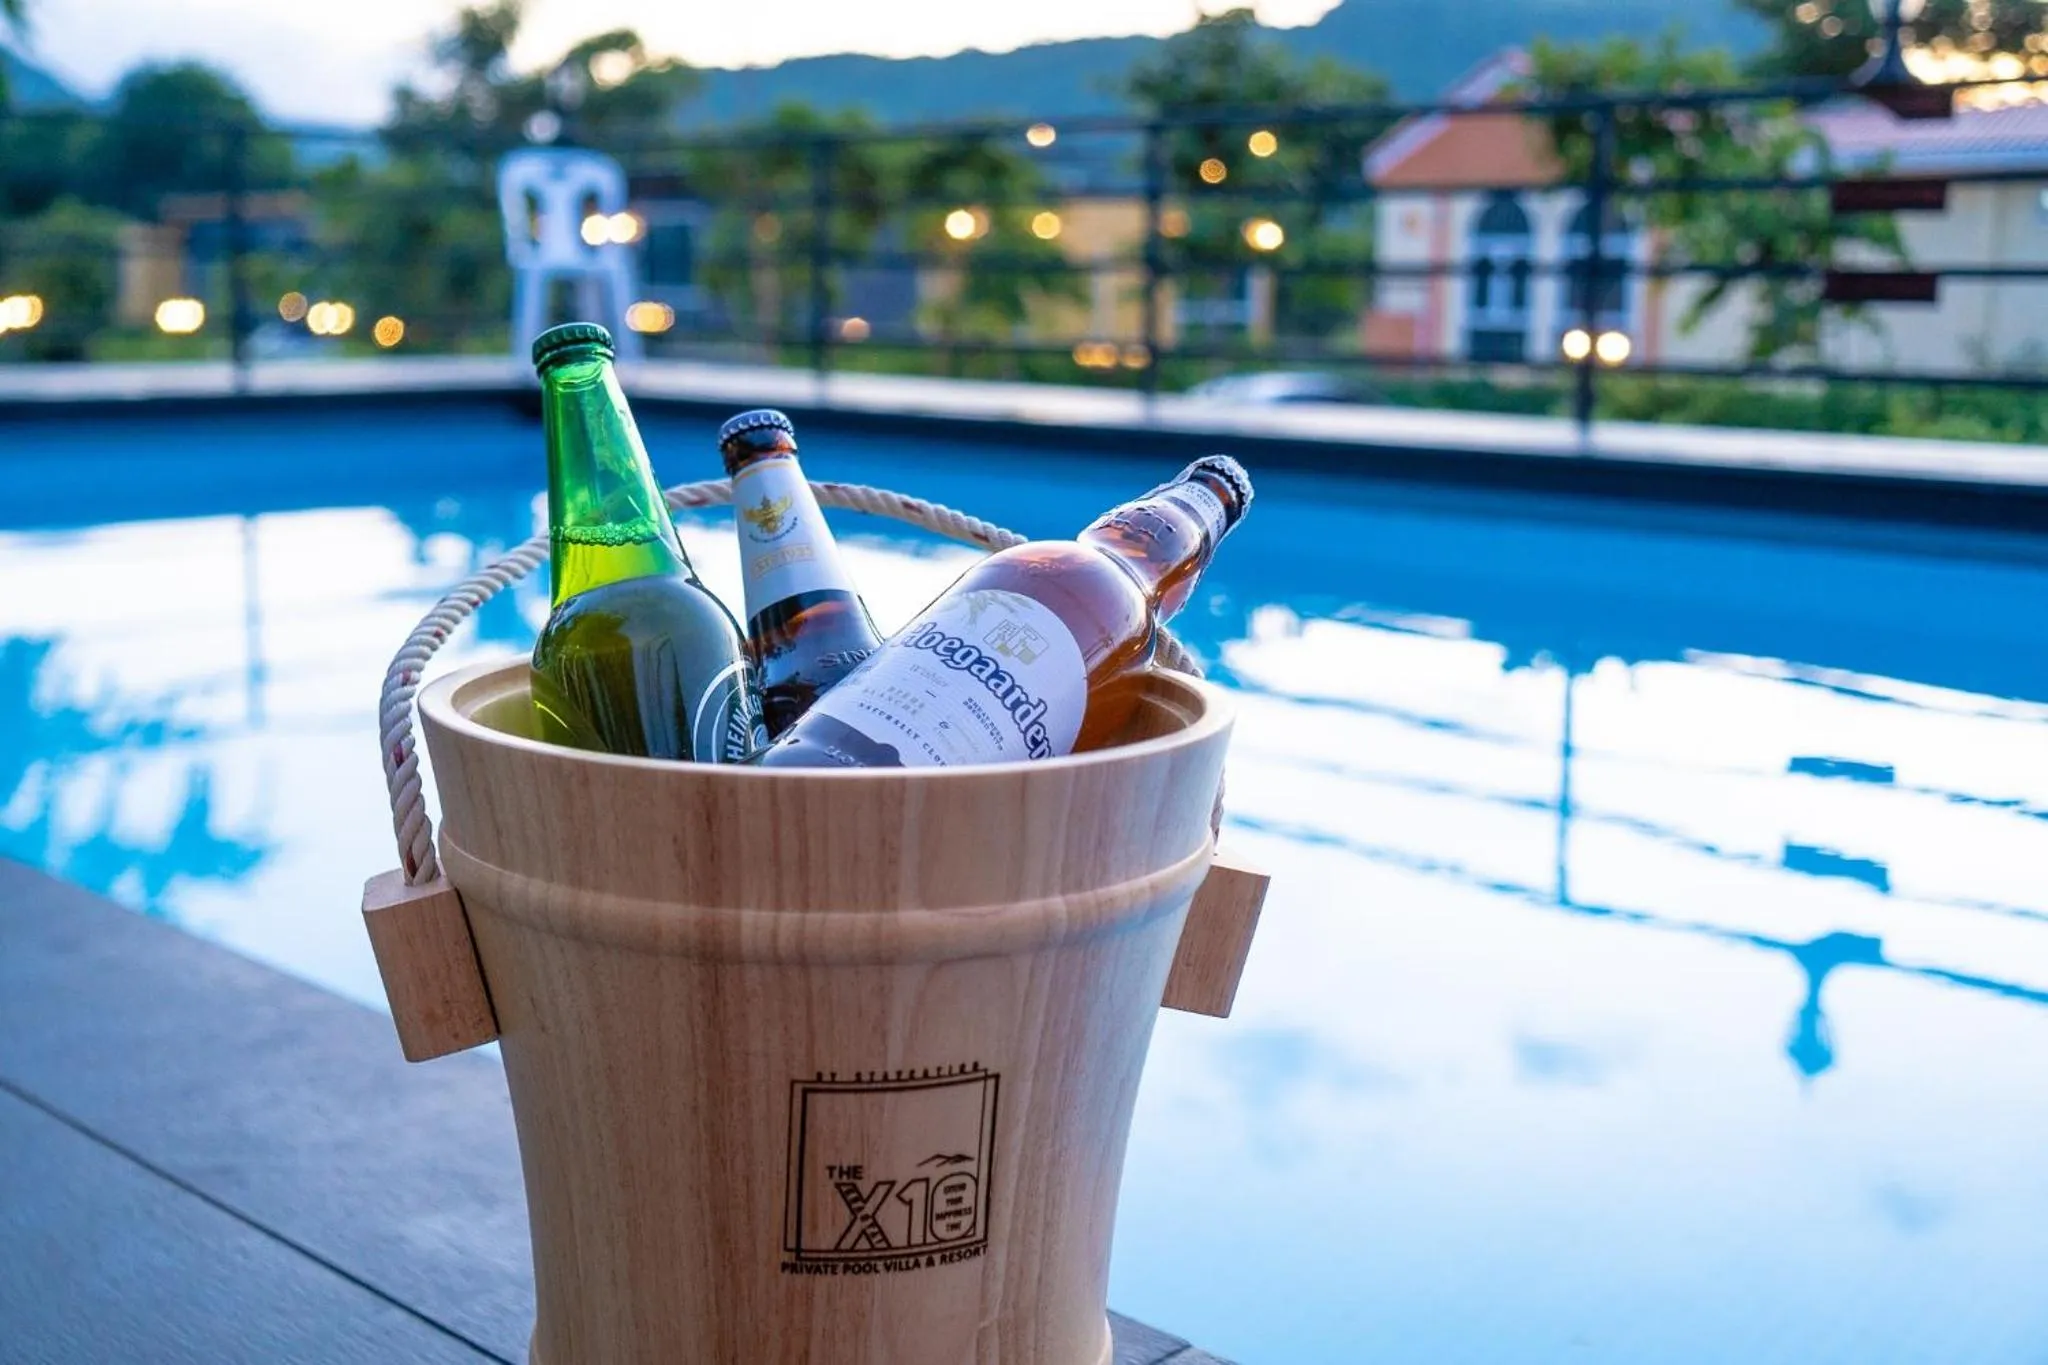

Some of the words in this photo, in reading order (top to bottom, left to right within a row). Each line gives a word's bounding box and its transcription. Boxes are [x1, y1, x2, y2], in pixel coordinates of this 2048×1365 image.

[826, 1165, 863, 1180] THE
[780, 1260, 838, 1275] PRIVATE
[842, 1260, 880, 1275] POOL
[884, 1256, 921, 1273] VILLA
[925, 1254, 936, 1268] &
[939, 1244, 988, 1265] RESORT
